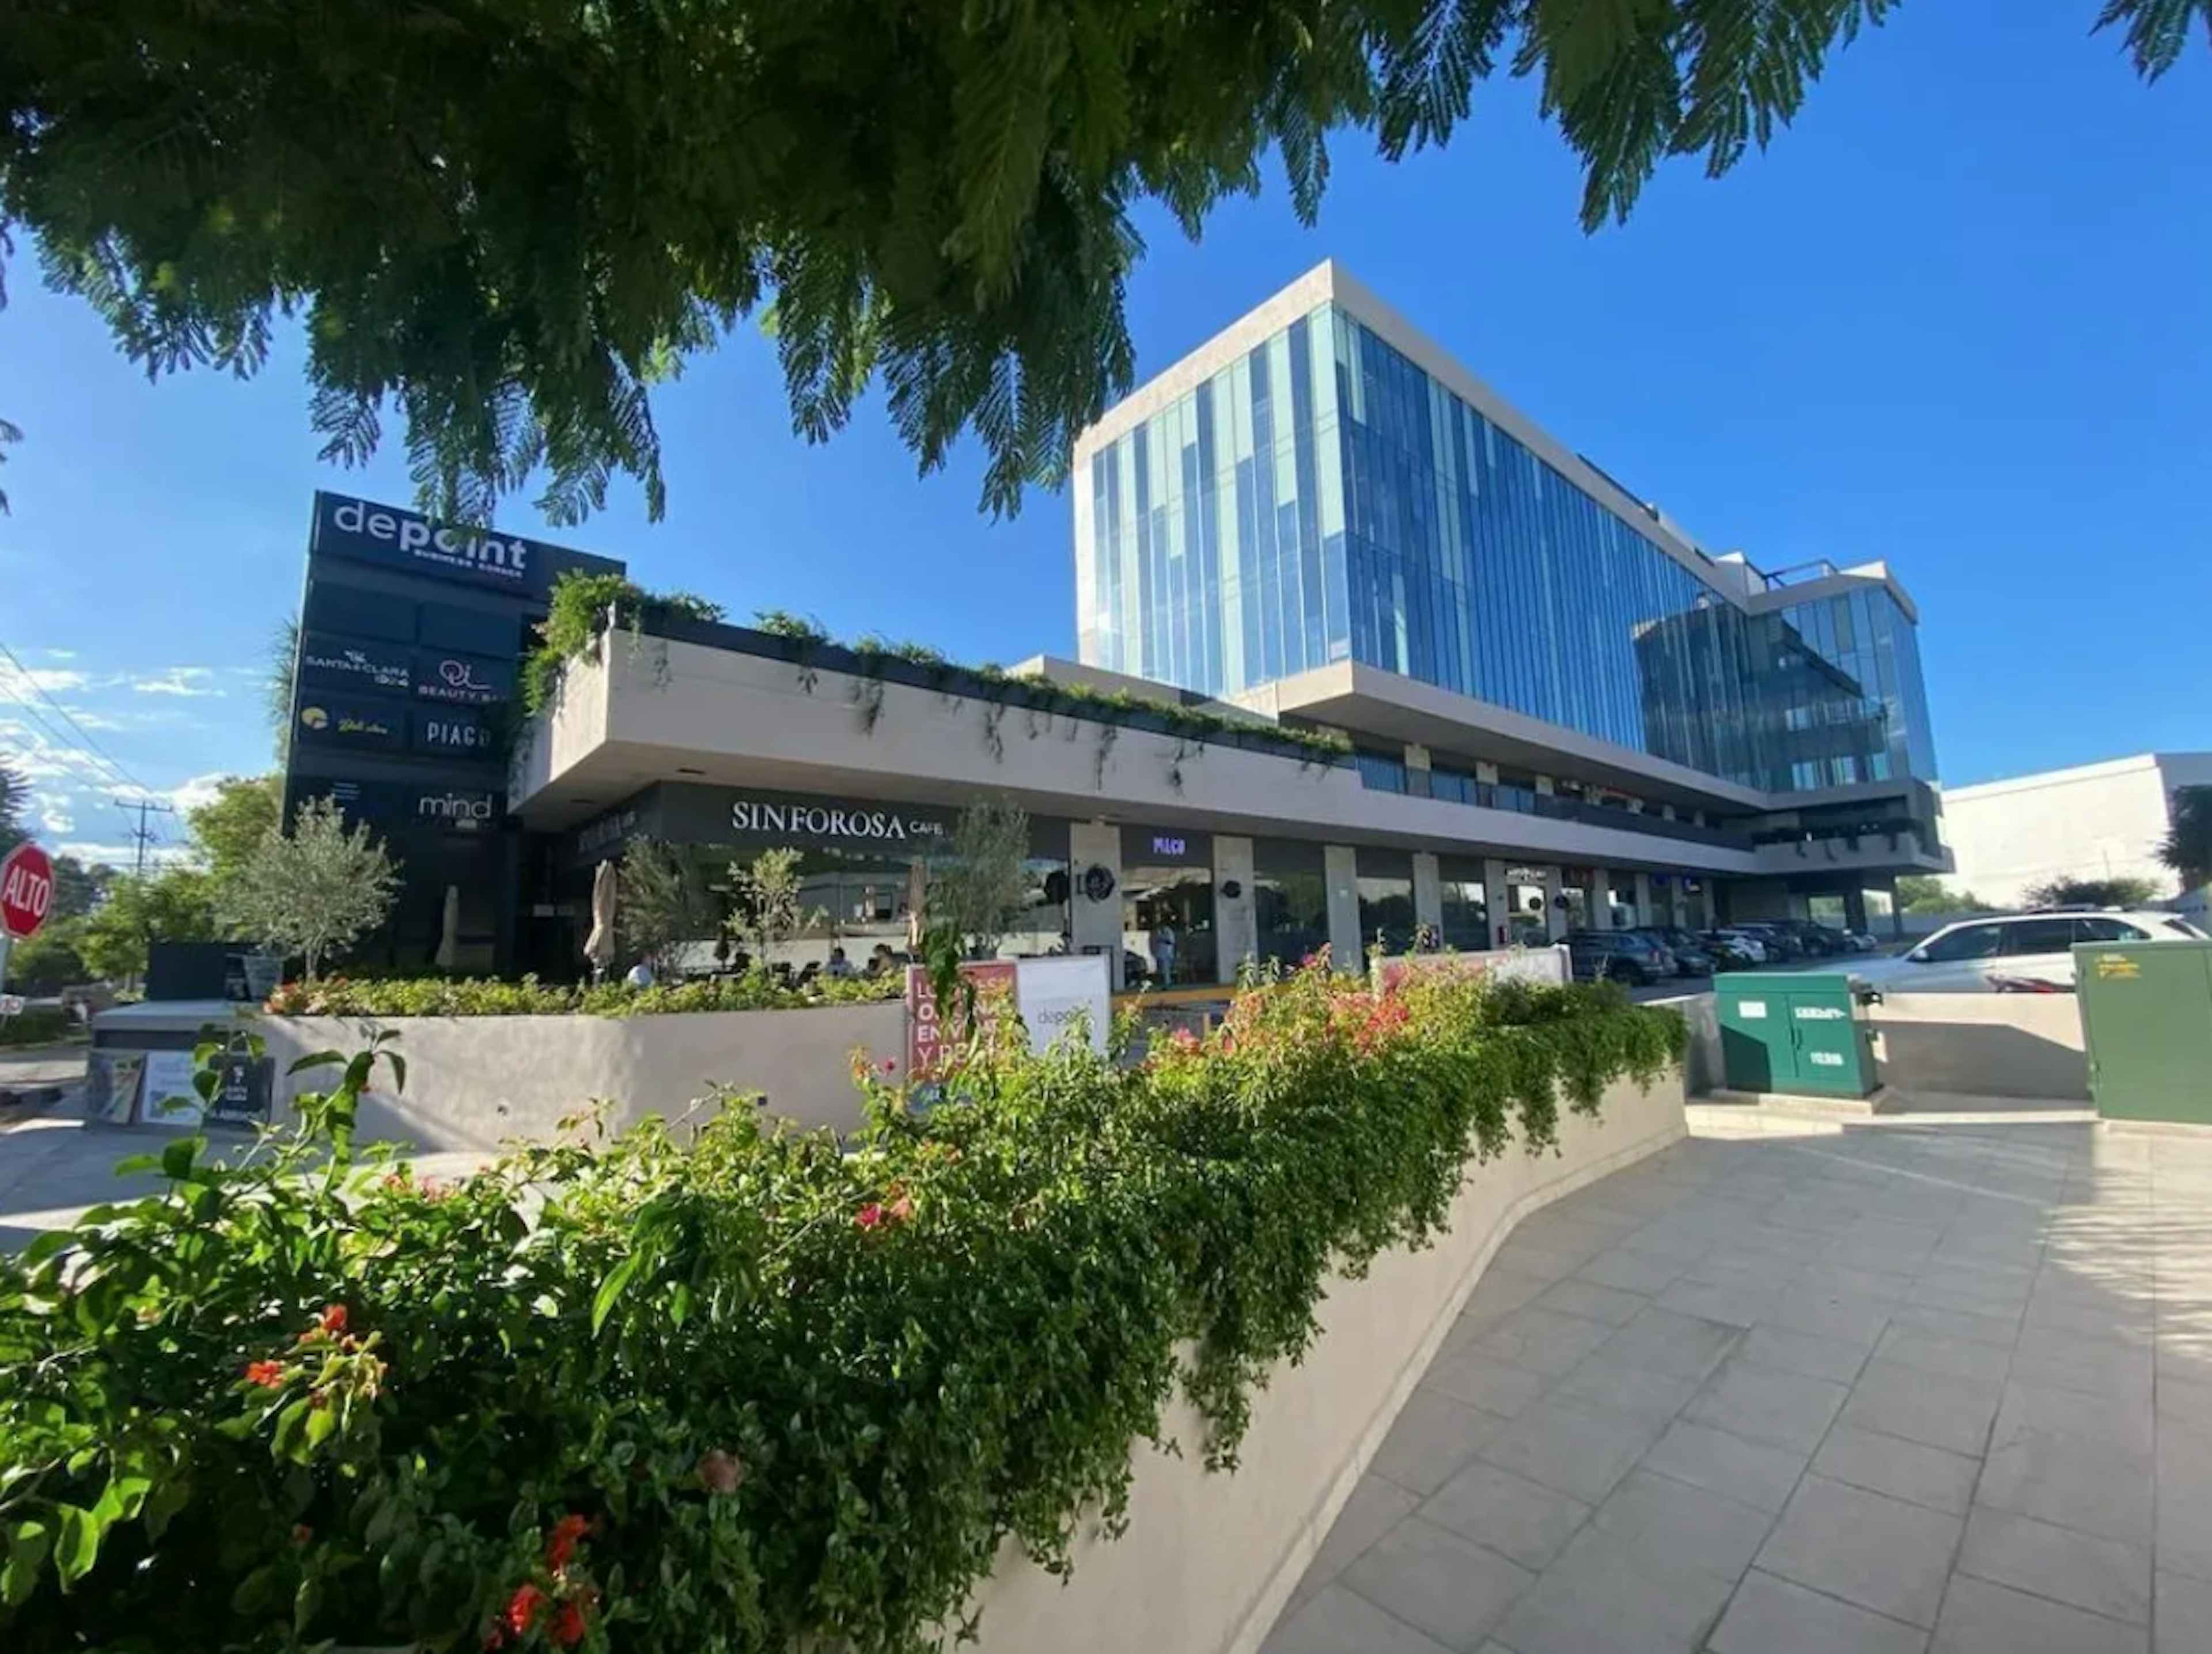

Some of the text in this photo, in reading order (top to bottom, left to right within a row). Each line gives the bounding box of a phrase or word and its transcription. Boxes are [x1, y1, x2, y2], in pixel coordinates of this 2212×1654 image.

[418, 685, 476, 699] BEAUTY
[419, 792, 493, 819] mind
[732, 800, 905, 840] SINFOROSA
[2, 865, 50, 917] ALTO
